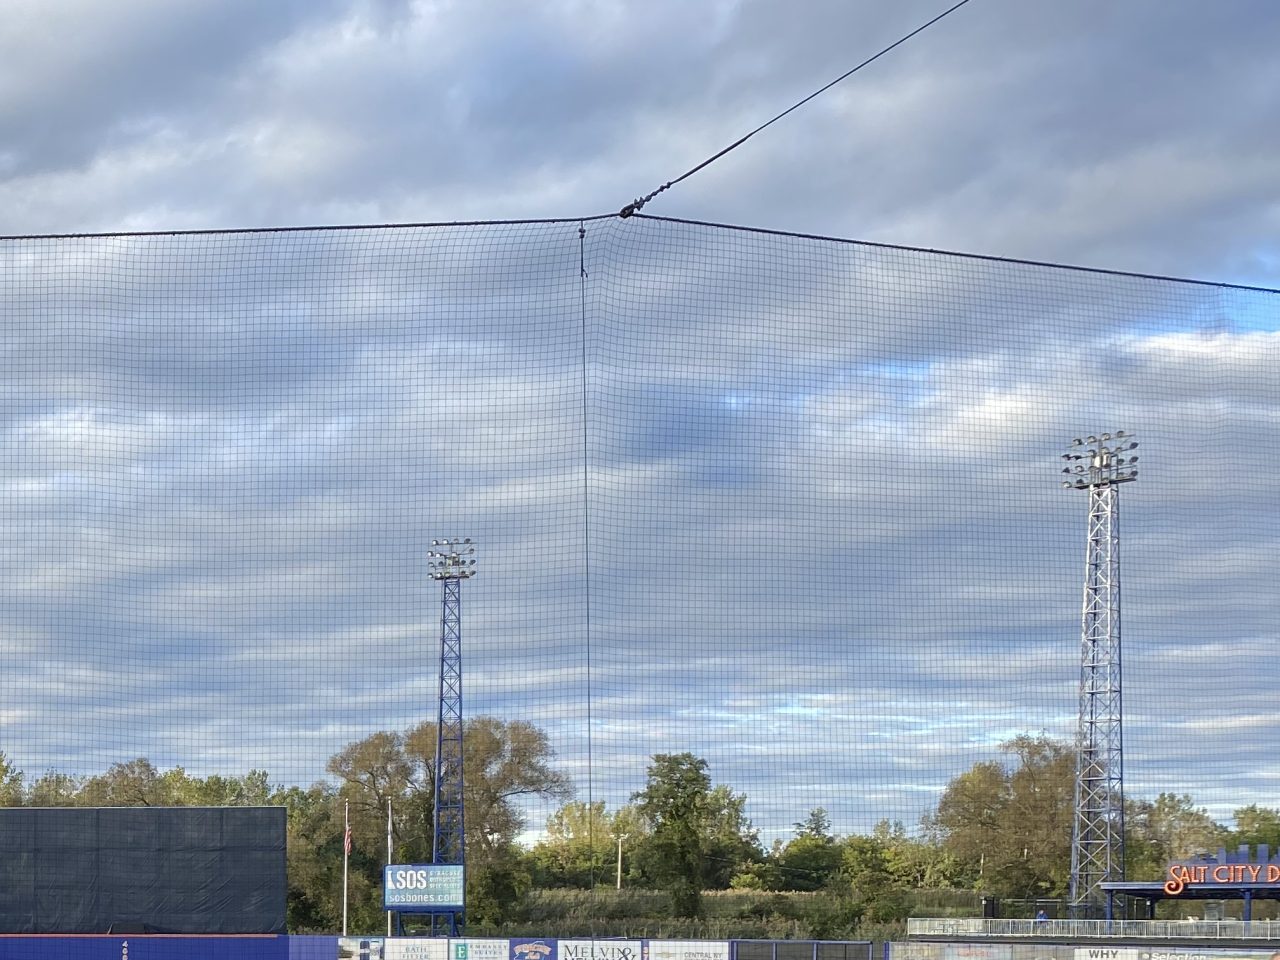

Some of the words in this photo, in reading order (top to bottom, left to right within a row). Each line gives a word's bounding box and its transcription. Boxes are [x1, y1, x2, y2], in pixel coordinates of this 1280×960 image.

[396, 870, 426, 890] SOS
[1164, 864, 1209, 895] SALT
[1213, 864, 1262, 883] CITY
[564, 944, 622, 957] MELVIN
[1088, 949, 1118, 958] WHY
[1151, 952, 1206, 960] Selection
